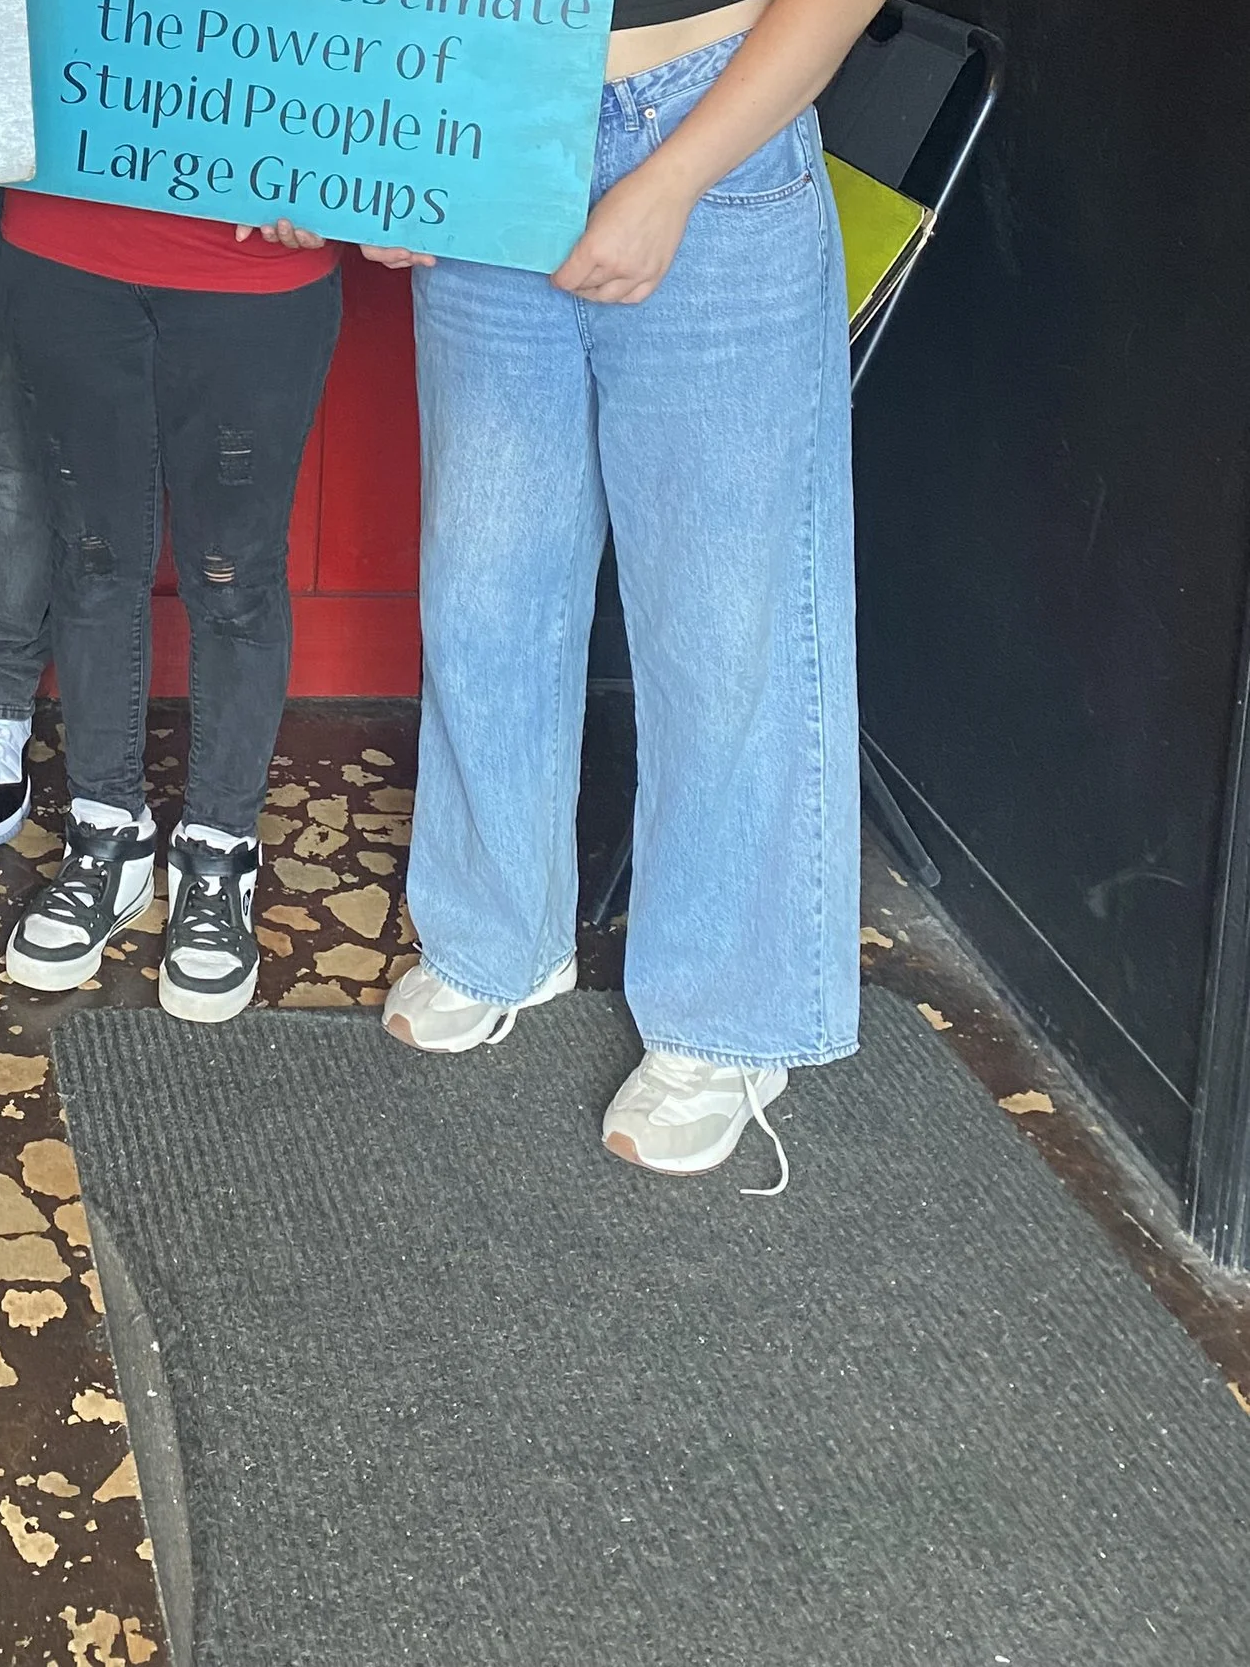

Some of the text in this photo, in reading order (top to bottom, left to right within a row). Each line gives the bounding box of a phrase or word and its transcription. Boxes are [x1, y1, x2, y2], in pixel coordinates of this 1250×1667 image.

[196, 7, 383, 74] Power
[396, 35, 463, 84] of
[60, 59, 484, 161] Stupid People in
[77, 128, 450, 232] Large Groups
